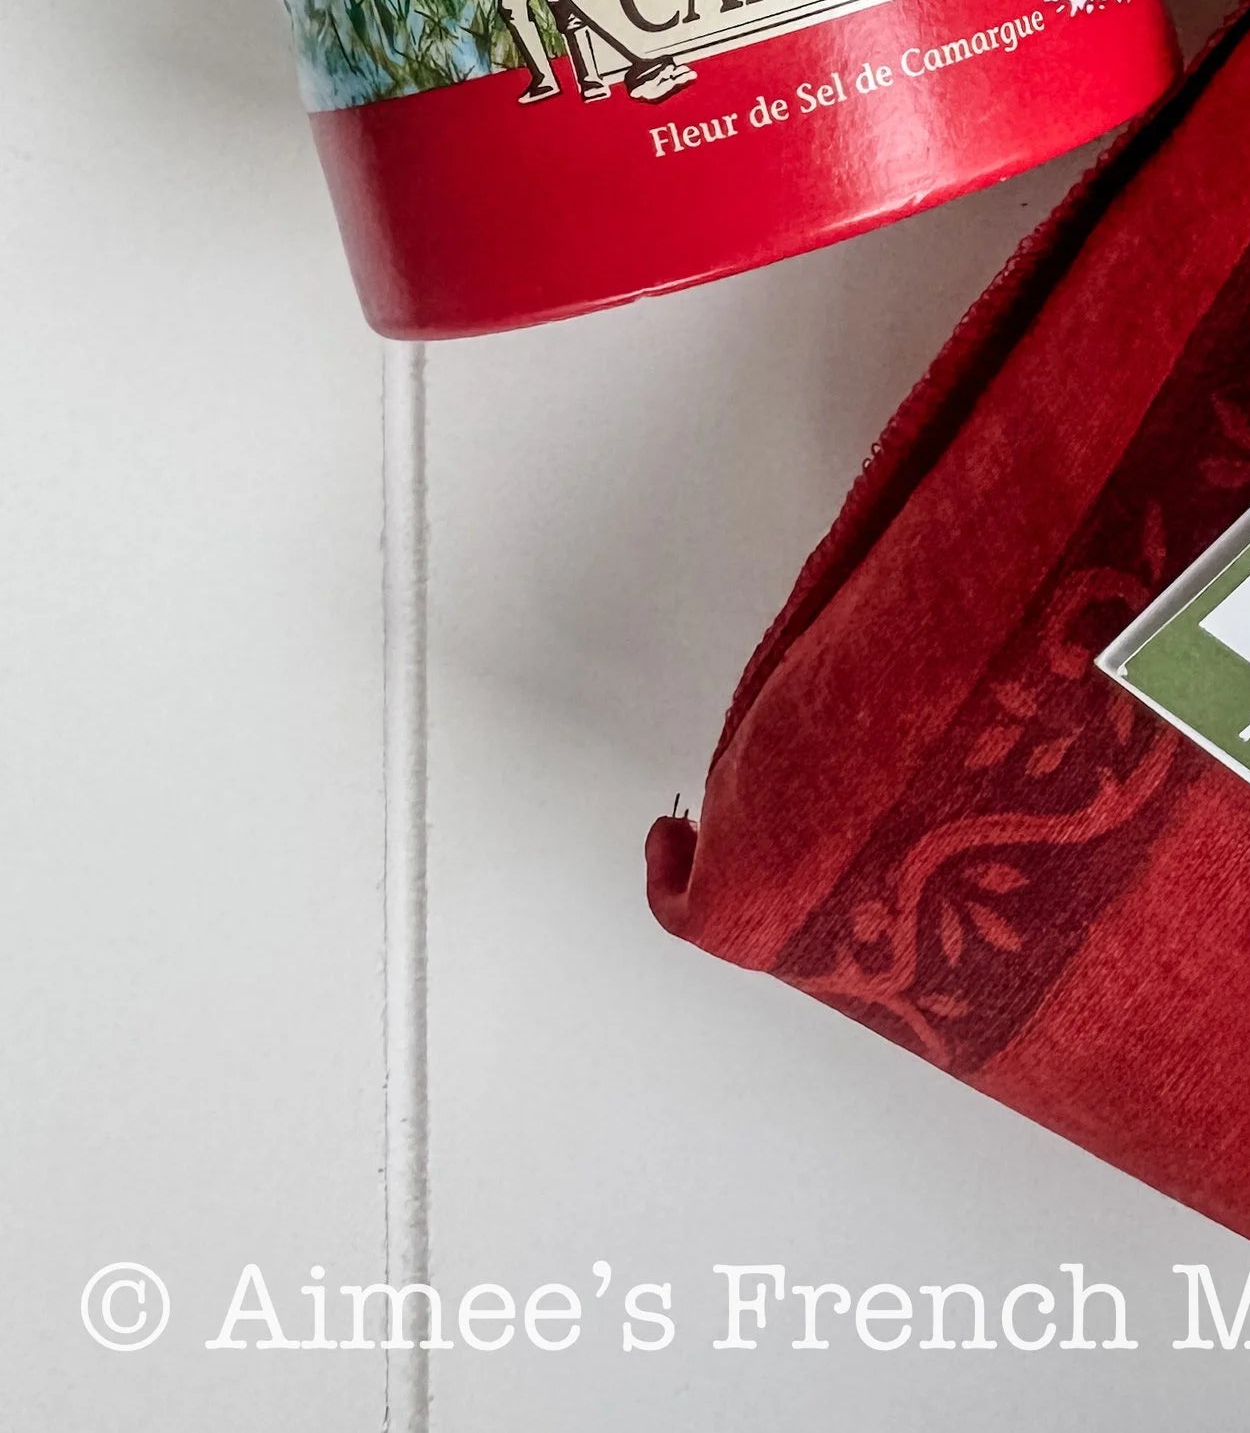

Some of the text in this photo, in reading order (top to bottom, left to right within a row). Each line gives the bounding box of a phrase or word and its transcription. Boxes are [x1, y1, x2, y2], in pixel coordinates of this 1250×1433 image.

[649, 9, 1046, 158] Fleur de Sel de Camargue
